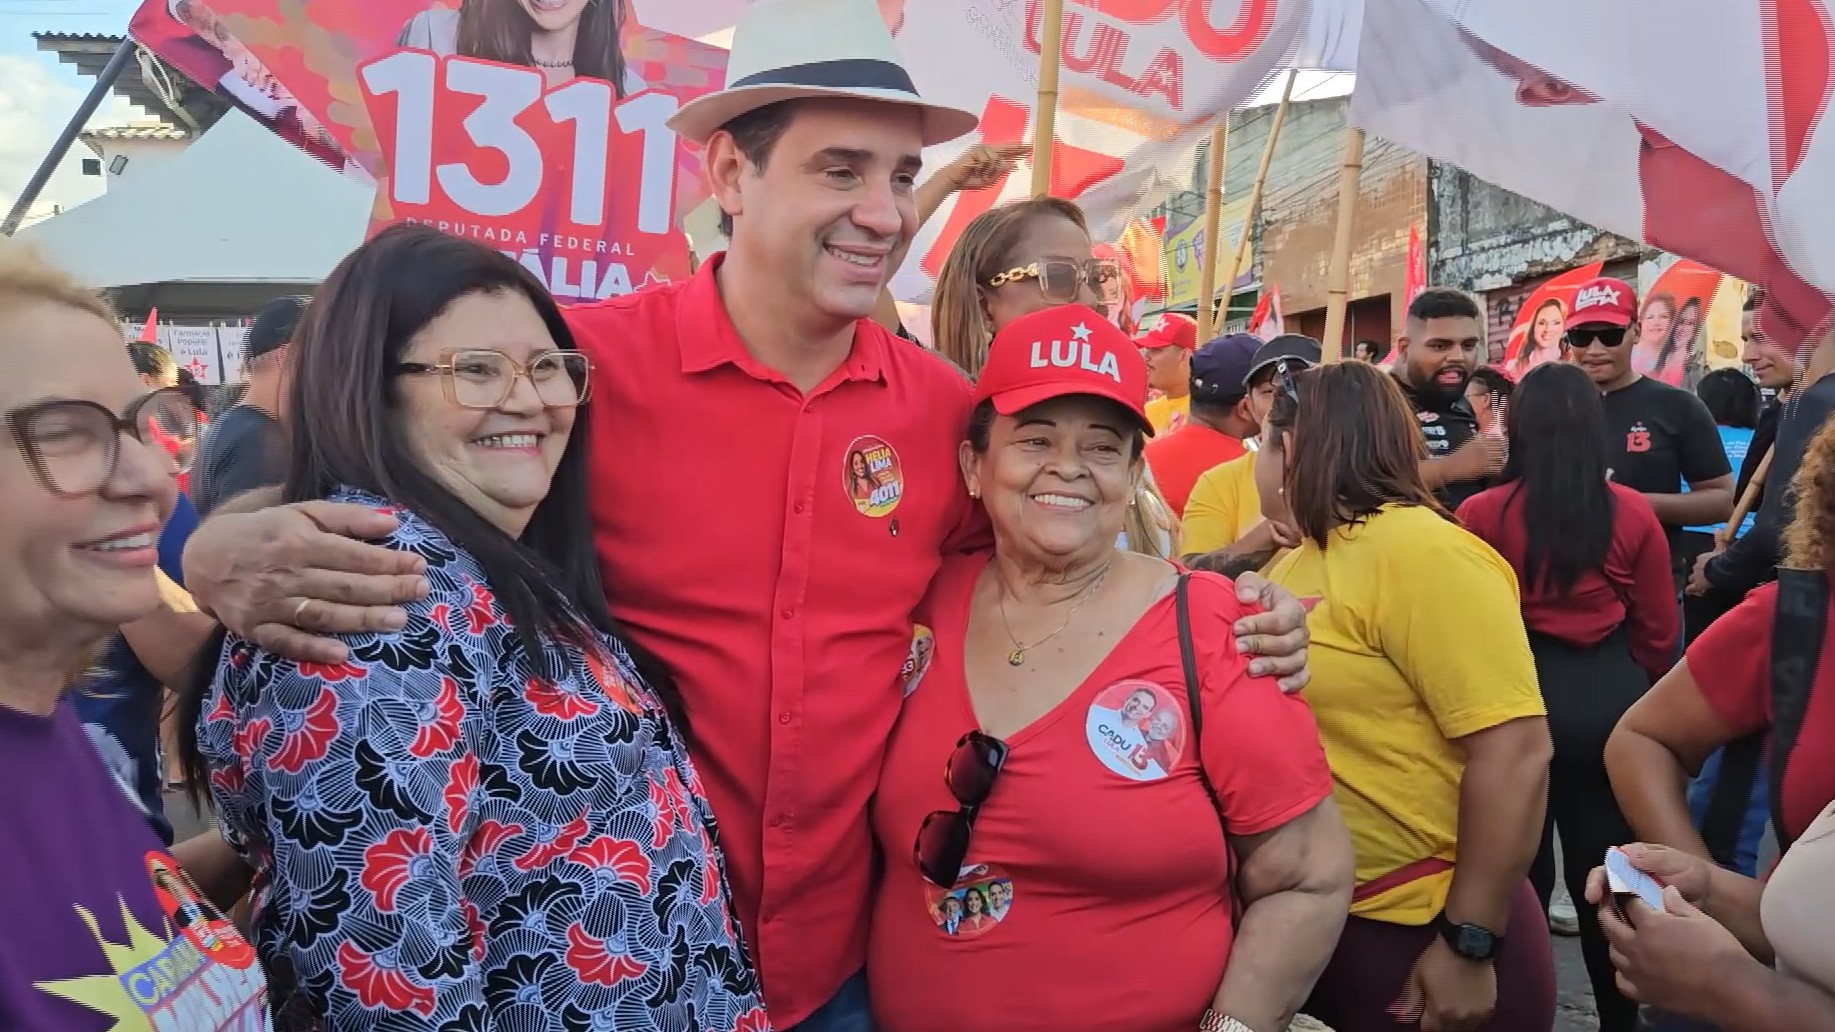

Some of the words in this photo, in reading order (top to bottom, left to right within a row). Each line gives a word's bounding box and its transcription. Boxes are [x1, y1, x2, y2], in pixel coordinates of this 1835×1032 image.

[1022, 0, 1184, 111] LULA
[361, 51, 678, 234] 1311
[539, 233, 635, 257] FEDERAL
[1030, 340, 1121, 384] LULA
[1626, 431, 1651, 453] 13
[870, 457, 892, 473] LIMA
[1098, 724, 1132, 751] CADU
